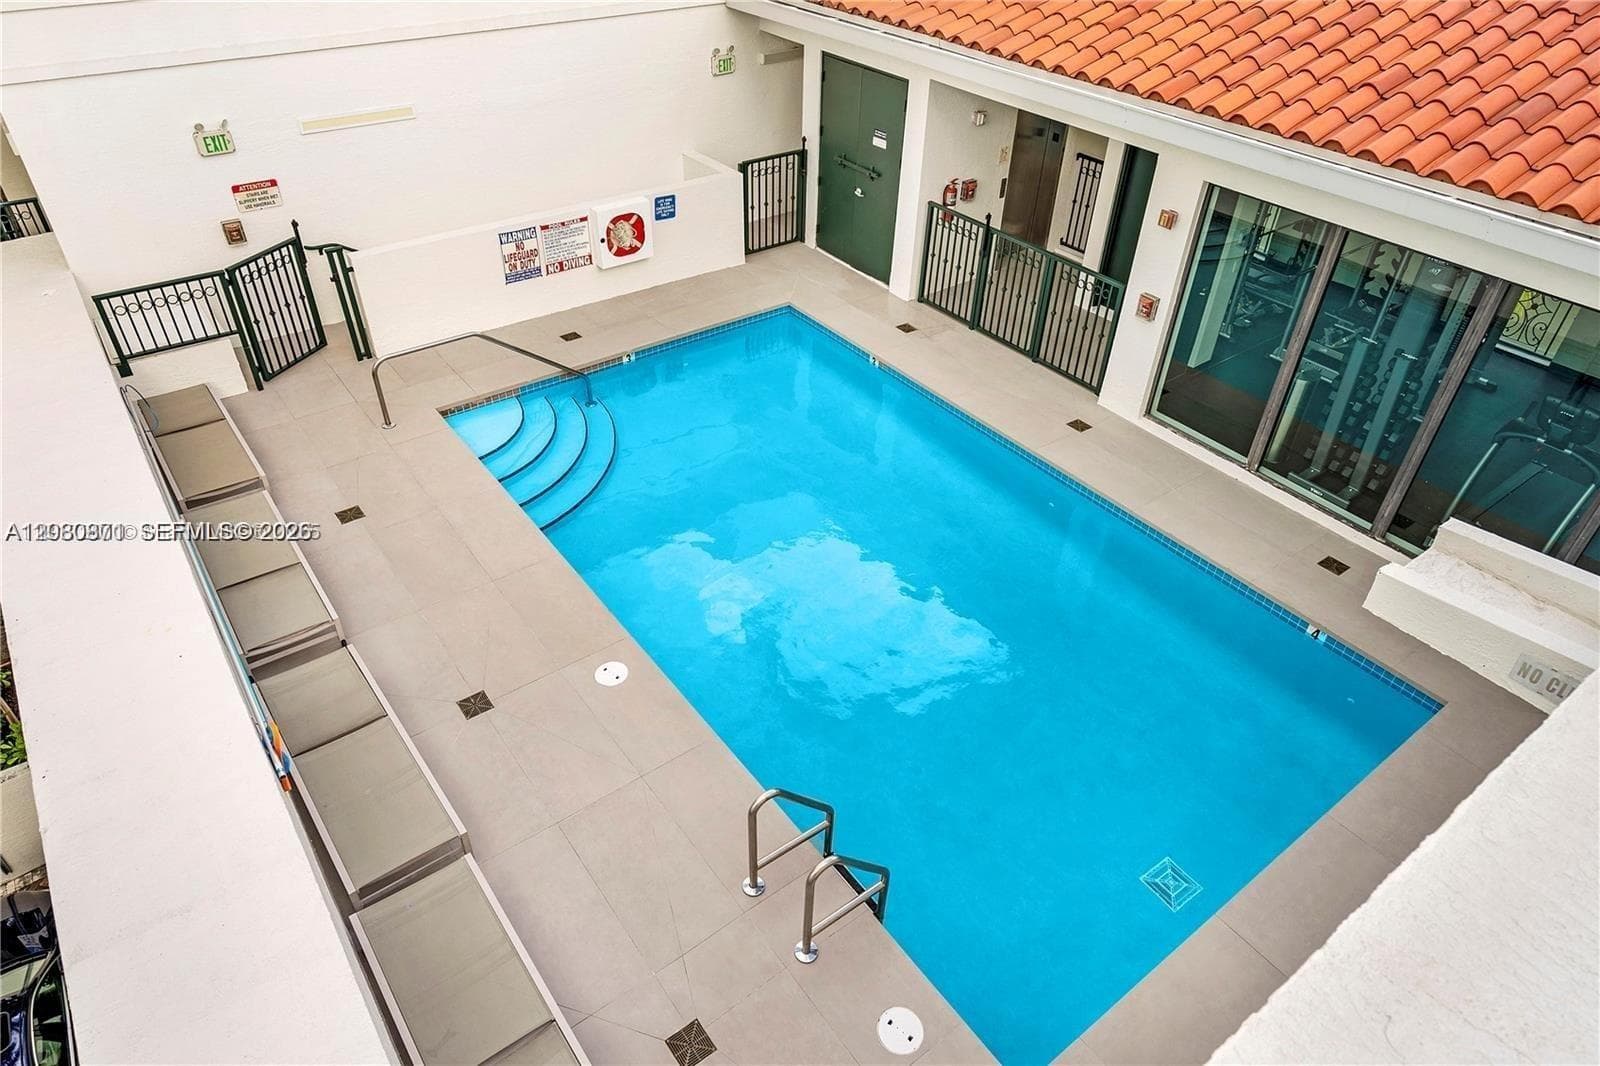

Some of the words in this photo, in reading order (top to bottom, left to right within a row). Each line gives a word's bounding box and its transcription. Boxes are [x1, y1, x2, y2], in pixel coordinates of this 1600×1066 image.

[718, 57, 732, 73] EXIT
[203, 134, 229, 153] EXIT
[239, 181, 272, 191] ATTENTION
[500, 228, 536, 244] WARNING
[515, 241, 525, 251] NO
[504, 248, 538, 264] LIFEGUARD
[508, 262, 518, 272] ON
[520, 259, 536, 270] DUTY
[548, 263, 560, 275] NO
[563, 255, 590, 271] DIVING
[1311, 628, 1321, 640] 4
[1517, 662, 1544, 685] NO
